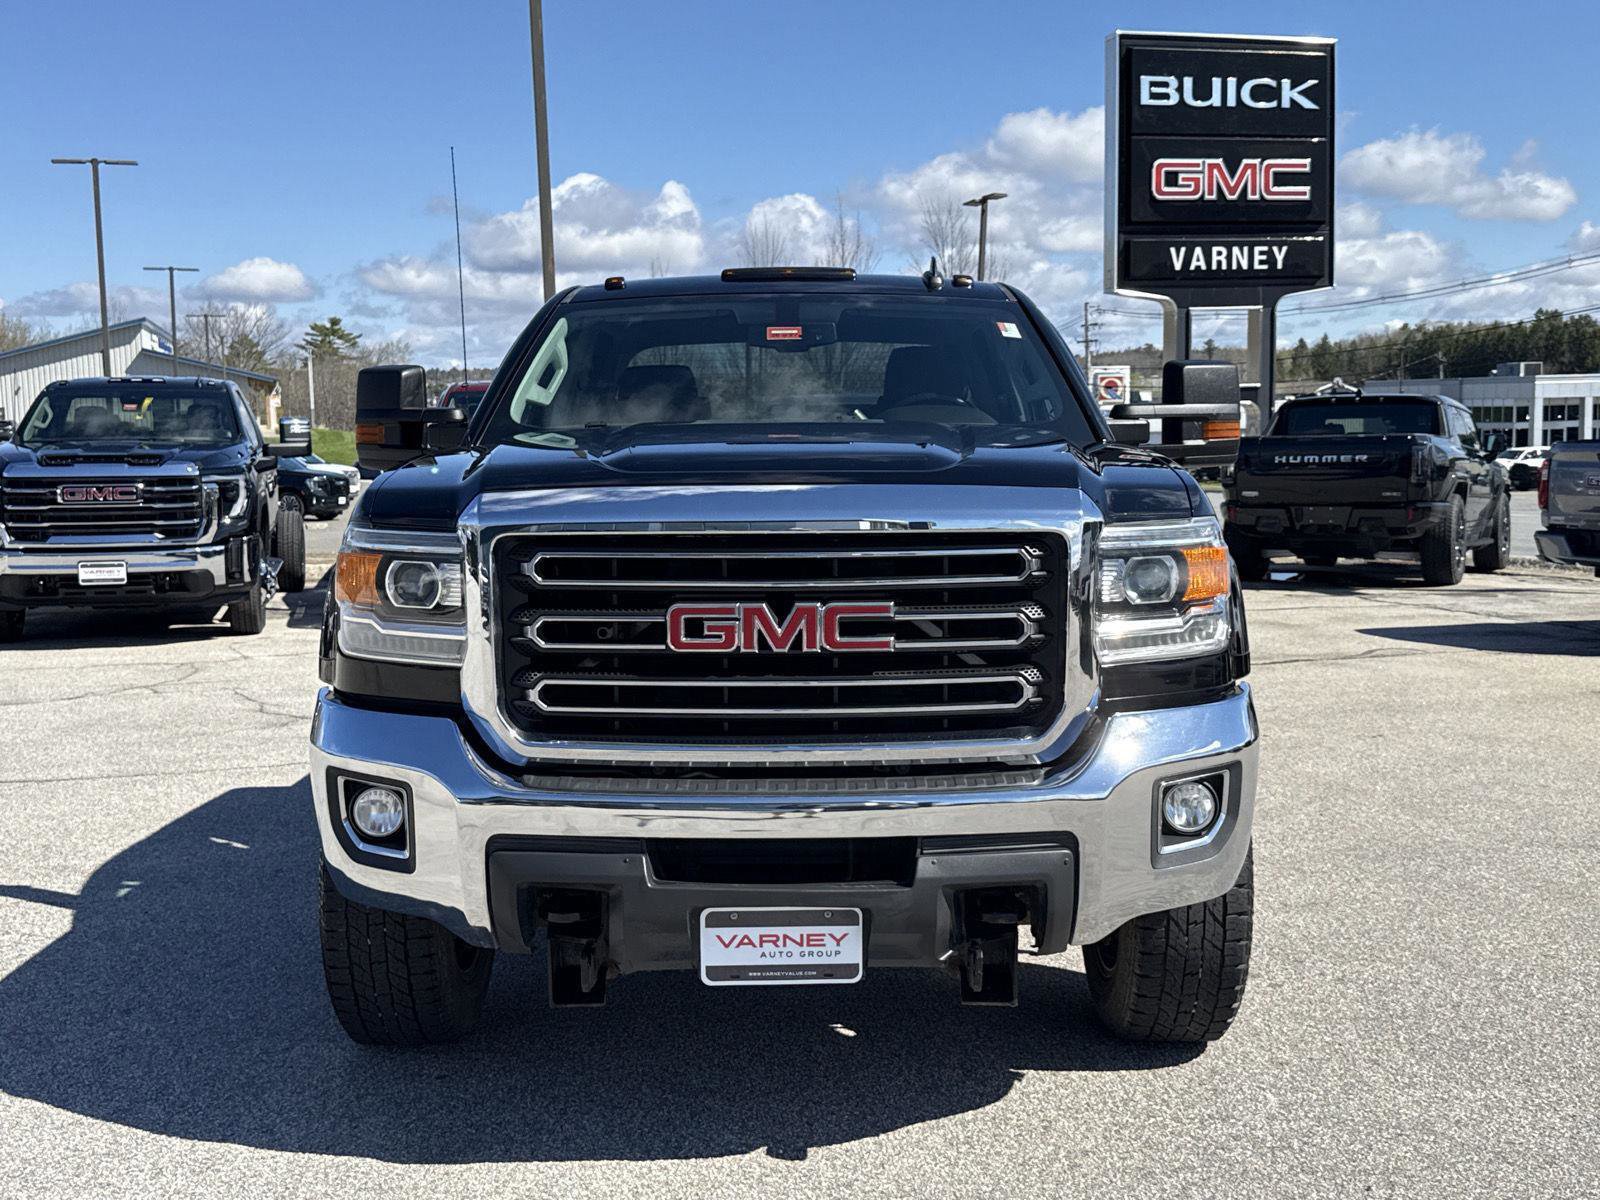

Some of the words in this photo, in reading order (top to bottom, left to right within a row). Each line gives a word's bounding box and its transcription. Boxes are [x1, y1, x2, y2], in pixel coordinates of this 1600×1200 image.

[1139, 75, 1320, 110] BUICK
[1151, 157, 1312, 202] GMC
[1169, 245, 1289, 272] VARNEY
[1274, 454, 1369, 464] HUMMER
[63, 486, 137, 501] GMC
[666, 601, 895, 653] GMC
[715, 932, 850, 949] VARNEY
[760, 950, 794, 959] AUTO
[799, 950, 842, 958] GROUP
